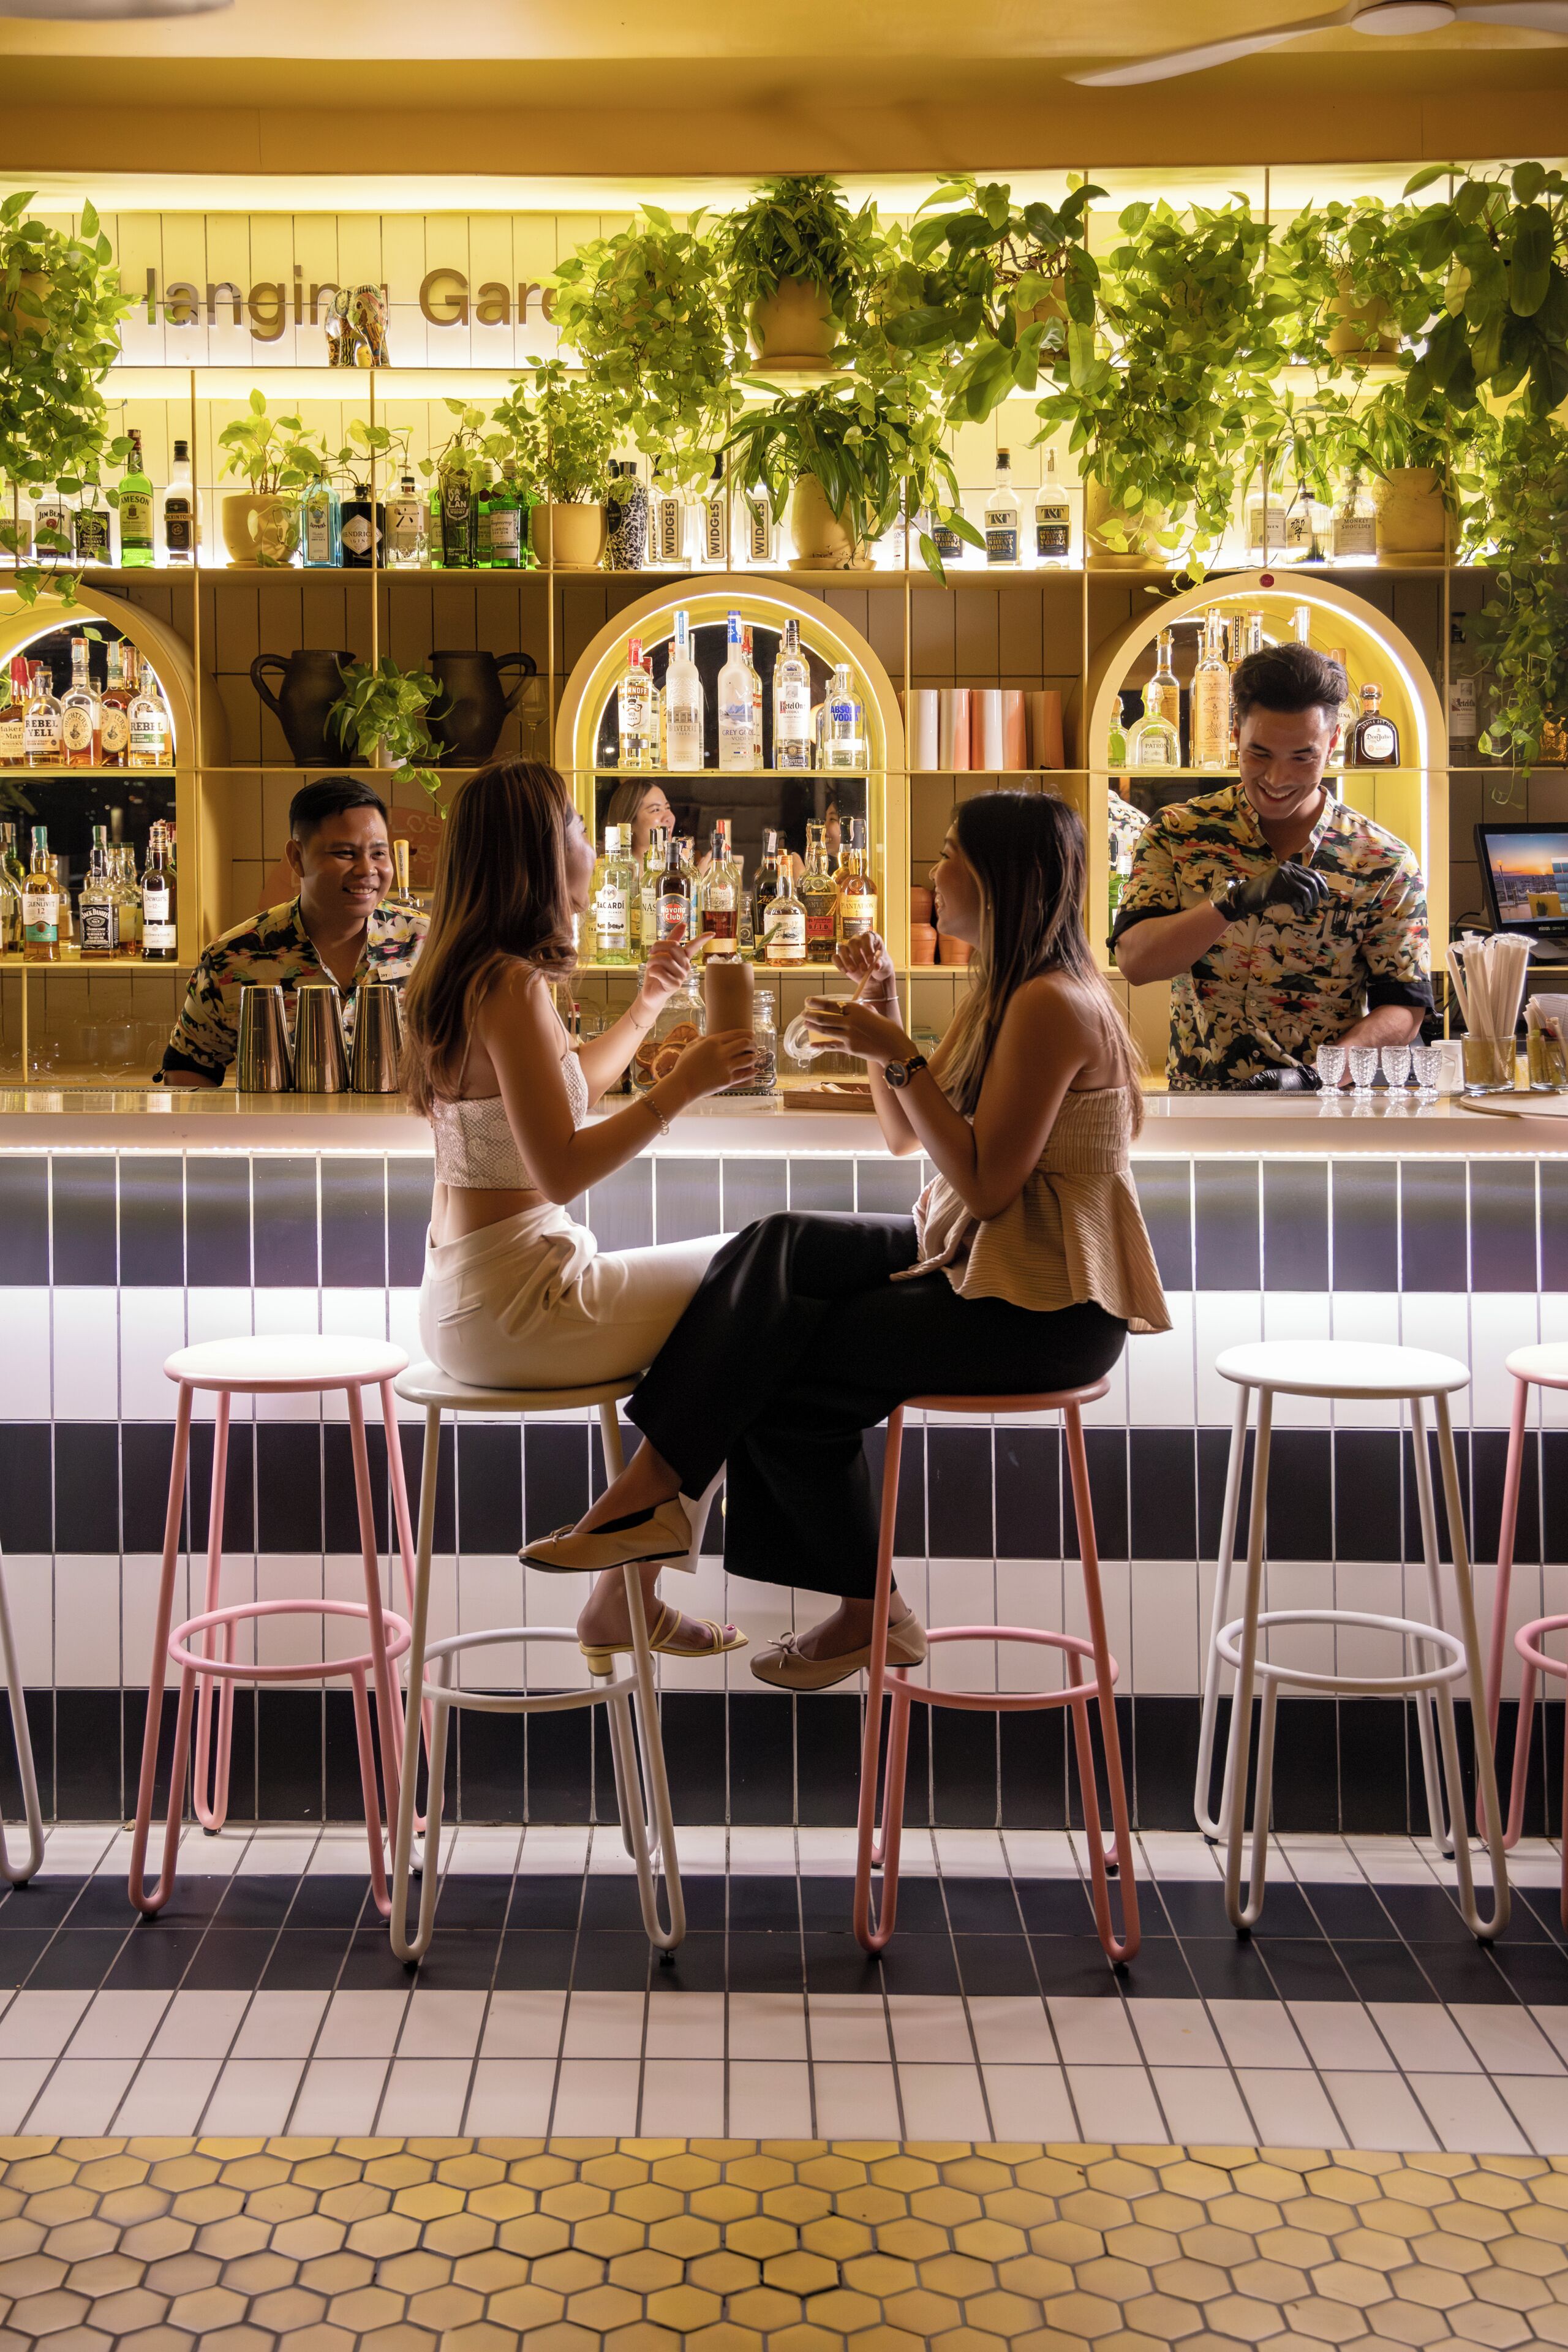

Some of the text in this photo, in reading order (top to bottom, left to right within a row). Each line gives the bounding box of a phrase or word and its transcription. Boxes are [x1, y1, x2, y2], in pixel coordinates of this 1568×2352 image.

[38, 511, 48, 521] JIM
[309, 521, 326, 530] SAPPHIRE
[665, 502, 675, 554] WIDGES
[710, 503, 720, 555] WIDGES
[25, 720, 58, 728] REBEL
[597, 900, 625, 909] BACARDÍ
[81, 910, 92, 919] JACK
